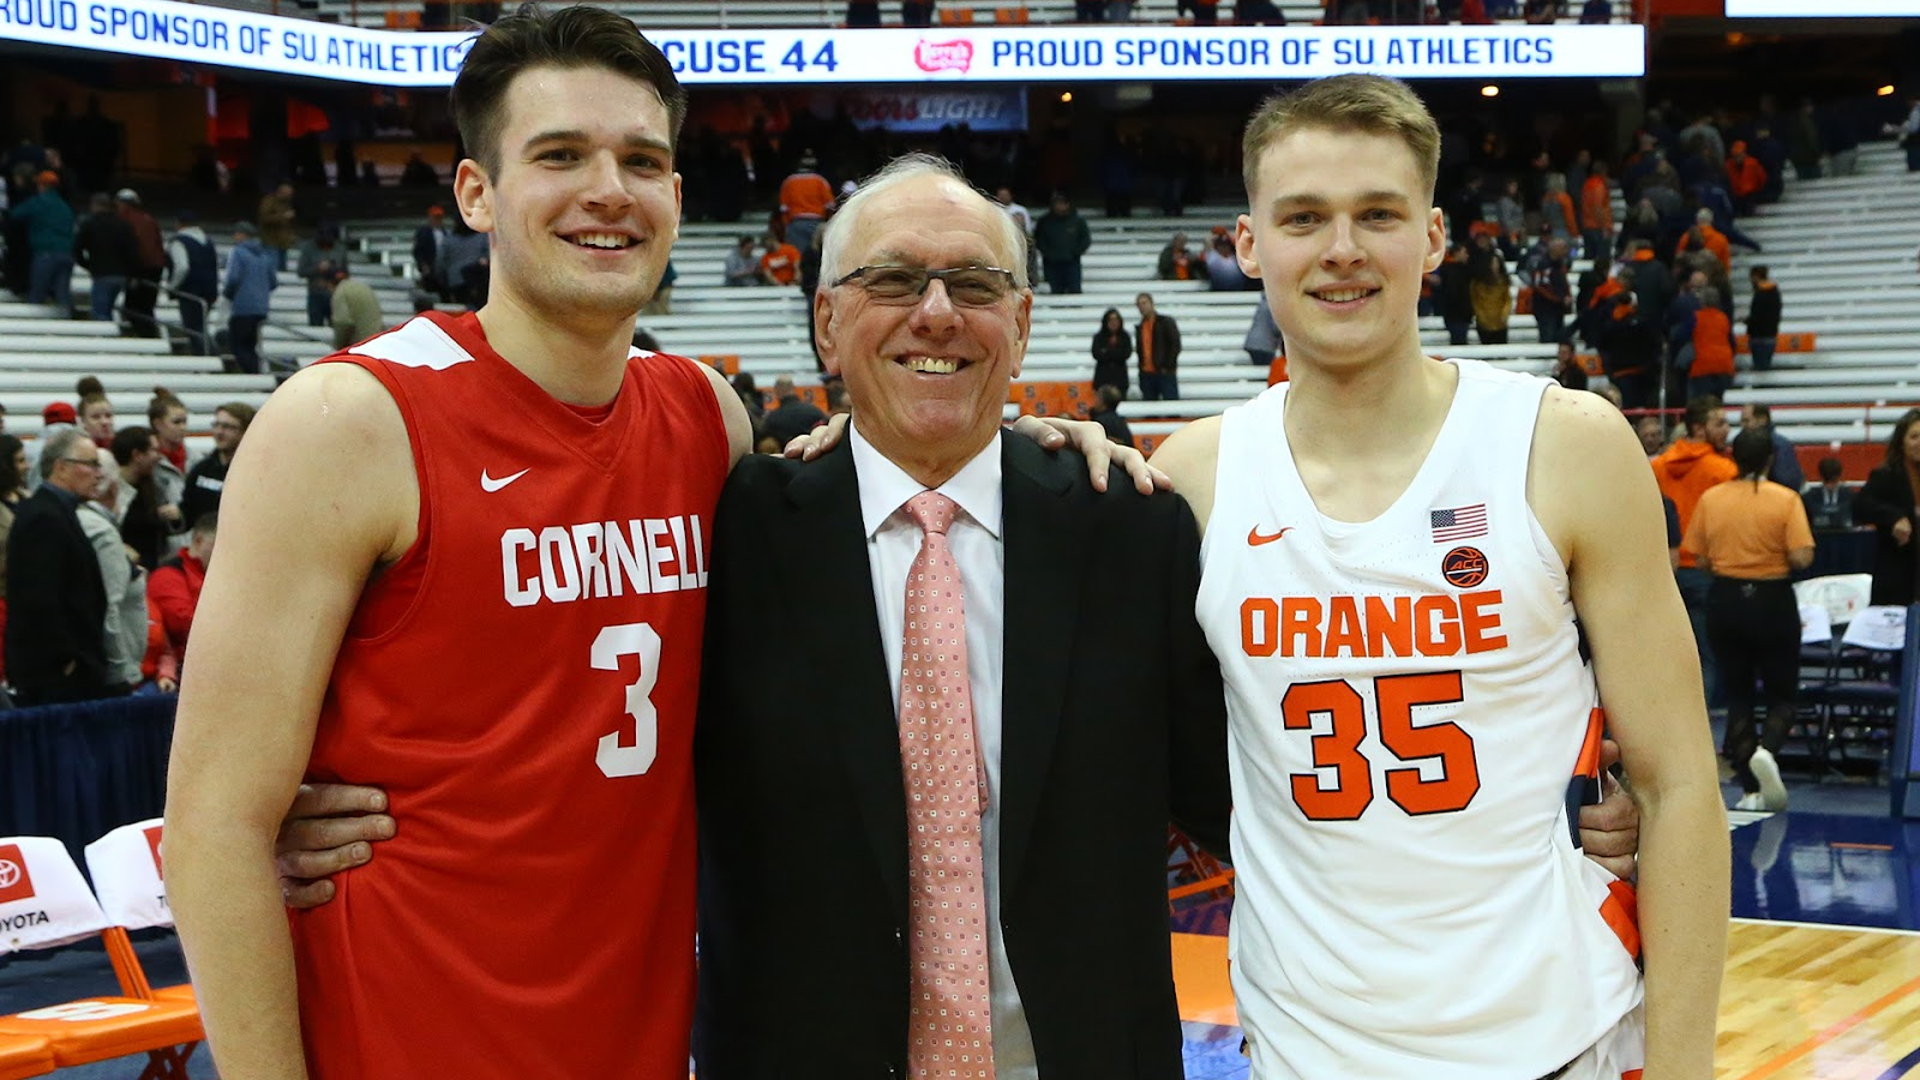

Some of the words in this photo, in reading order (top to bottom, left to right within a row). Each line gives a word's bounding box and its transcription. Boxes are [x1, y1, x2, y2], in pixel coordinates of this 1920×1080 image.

[0, 0, 77, 31] ROUD
[89, 5, 229, 50] SPONSOR
[239, 25, 272, 56] OF
[283, 31, 316, 62] SU
[326, 38, 463, 72] ATHLETIC
[660, 40, 766, 73] CUSE
[780, 39, 840, 72] 44
[992, 40, 1104, 66] PROUD
[1115, 39, 1270, 66] SPONSOR
[1281, 39, 1322, 65] OF
[1333, 39, 1375, 65] SU
[1386, 38, 1554, 65] ATHLETICS
[501, 514, 708, 607] CORNELL
[1450, 558, 1484, 570] ACC
[1240, 589, 1508, 658] ORANGE
[590, 622, 661, 778] 3
[1280, 669, 1481, 821] 35
[0, 910, 50, 932] YOTA
